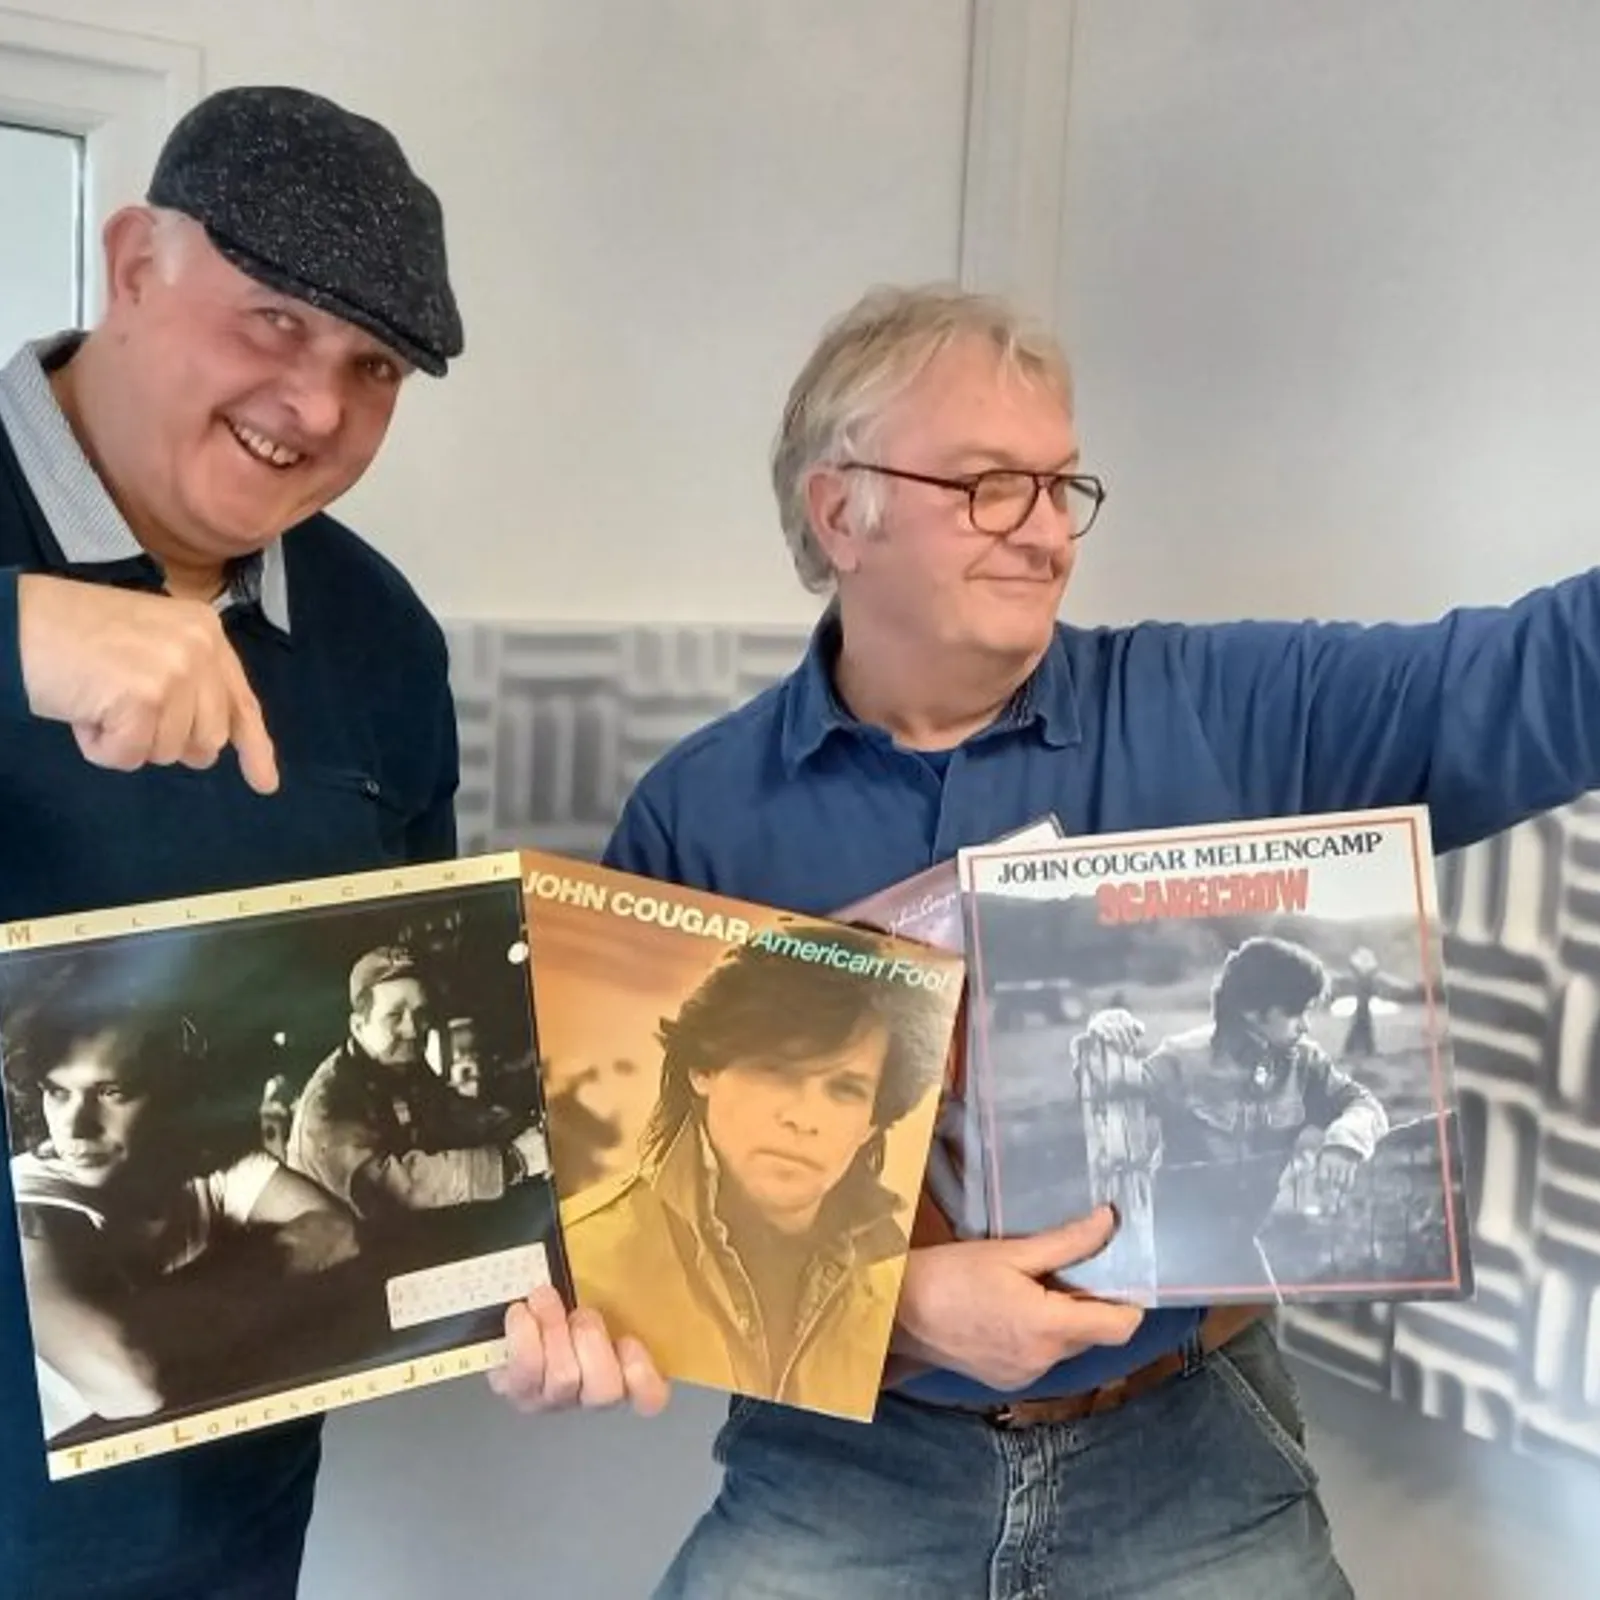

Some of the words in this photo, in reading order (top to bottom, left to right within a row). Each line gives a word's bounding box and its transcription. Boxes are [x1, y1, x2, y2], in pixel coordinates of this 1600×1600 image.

[998, 858, 1068, 885] JOHN
[1073, 848, 1187, 878] COUGAR
[1194, 831, 1383, 868] MELLENCAMP
[1095, 867, 1309, 926] SCARECROW
[522, 870, 607, 912] JOHN
[610, 891, 751, 945] COUGAR
[752, 929, 886, 980] American
[887, 959, 951, 992] Fool
